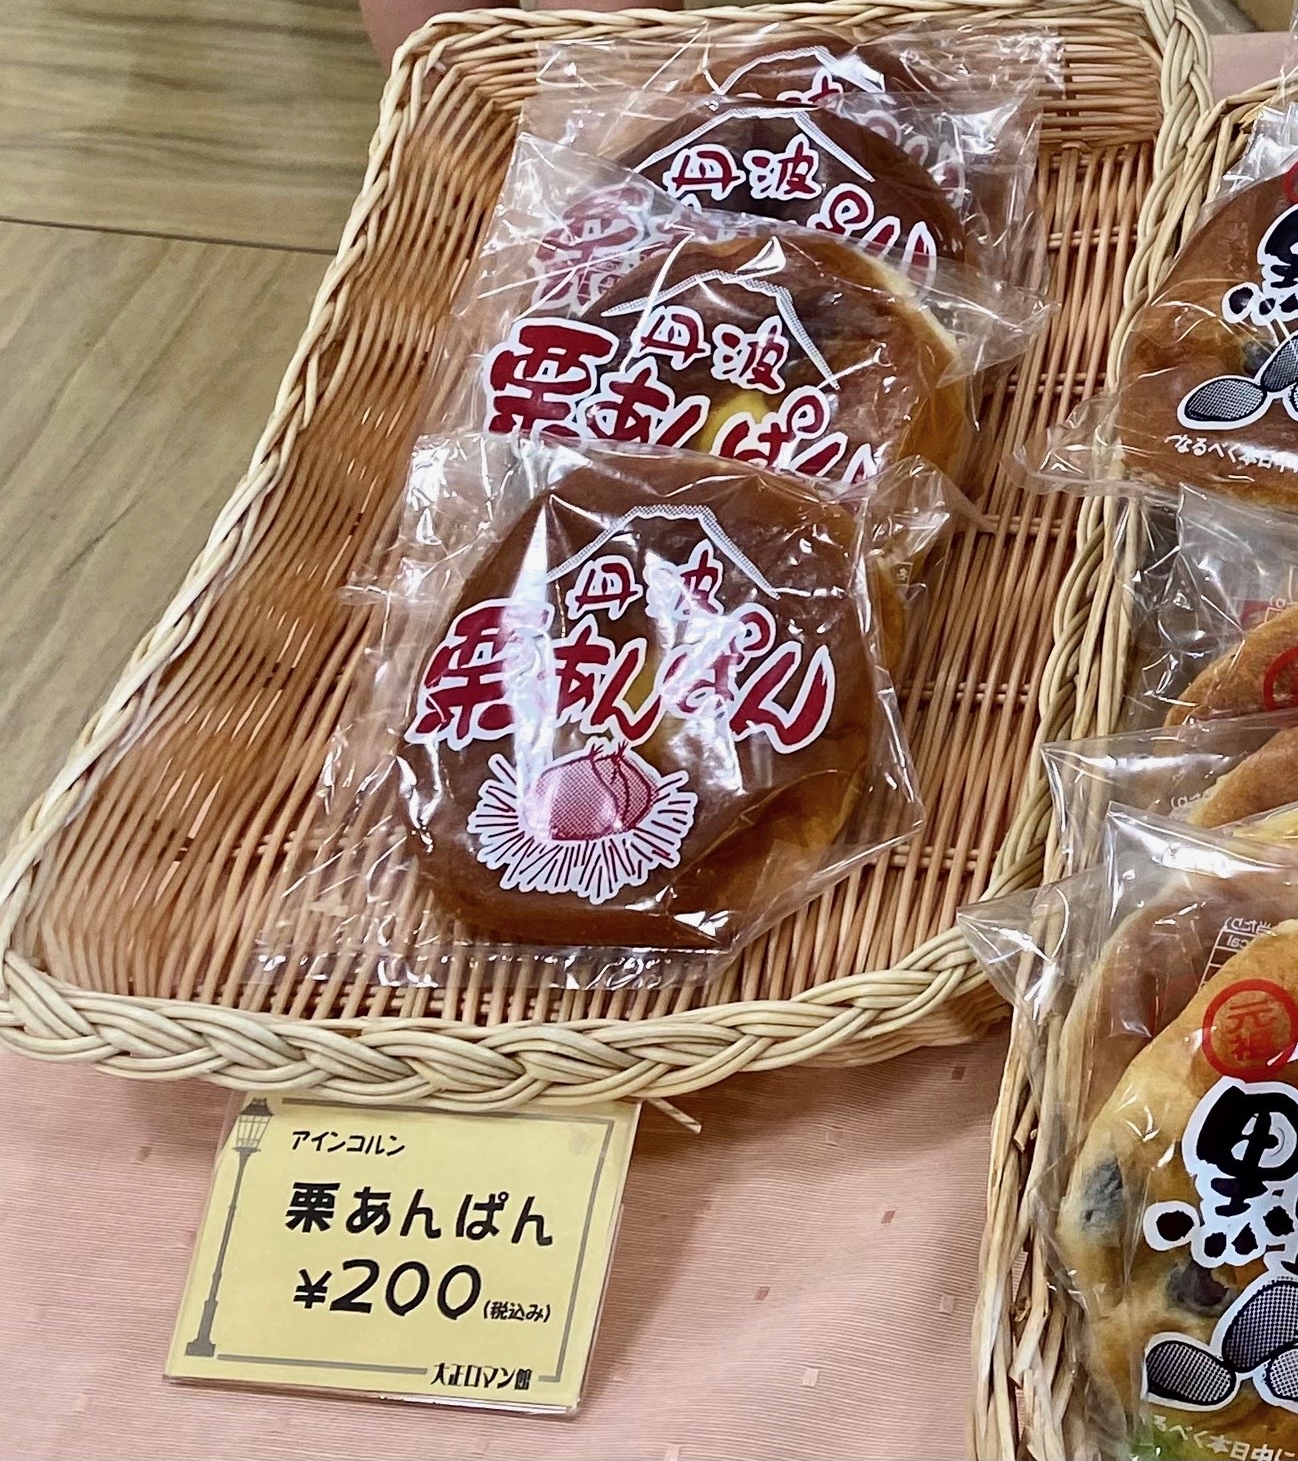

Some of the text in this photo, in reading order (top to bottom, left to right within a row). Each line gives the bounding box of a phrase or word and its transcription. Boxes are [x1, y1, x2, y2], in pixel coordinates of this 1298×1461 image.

[663, 133, 822, 201] 丹波
[629, 305, 790, 397] 丹波
[290, 1129, 406, 1158] アインコルン
[285, 1181, 554, 1247] 栗あんぱん
[292, 1257, 552, 1324] ¥200 (税込み)
[430, 1362, 533, 1393] 大正ロマン館
